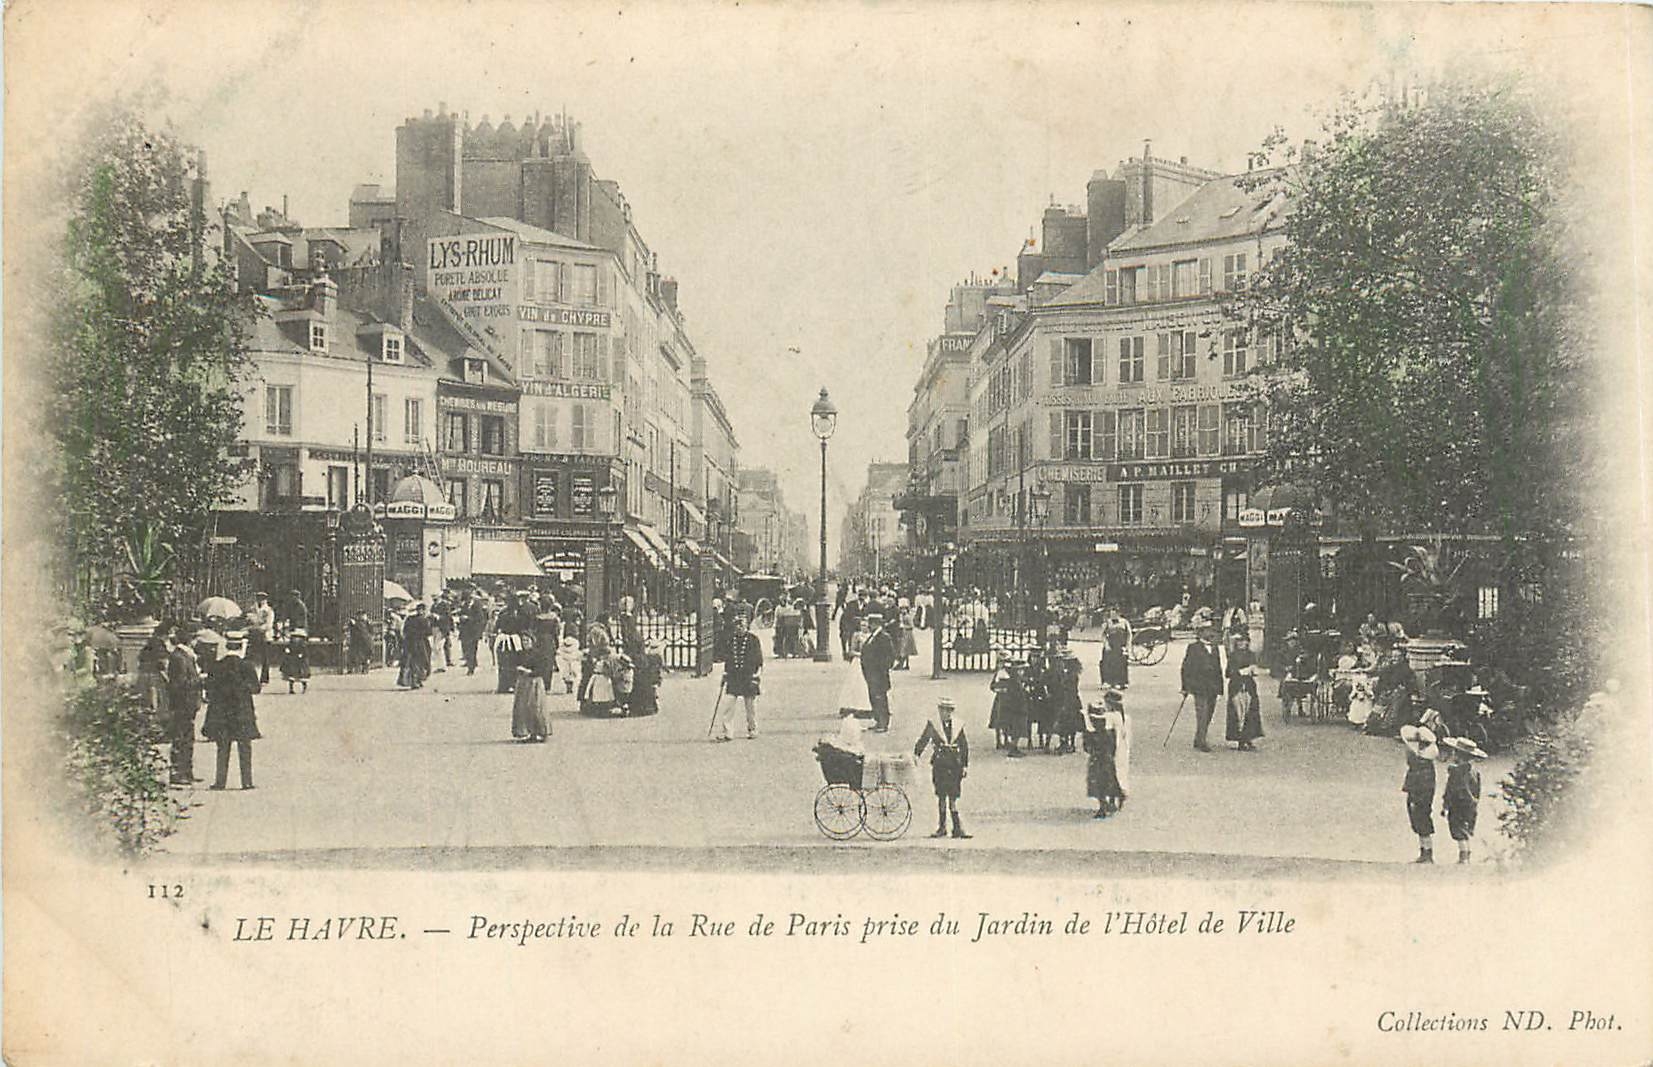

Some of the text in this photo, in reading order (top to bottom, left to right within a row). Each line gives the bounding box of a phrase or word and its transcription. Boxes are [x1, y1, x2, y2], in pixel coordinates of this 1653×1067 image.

[430, 237, 514, 269] LYS-RHUM
[519, 305, 538, 320] VIN
[561, 310, 609, 326] CHYPRE
[521, 381, 542, 396] VIN
[1038, 464, 1105, 483] CHEMISERIE
